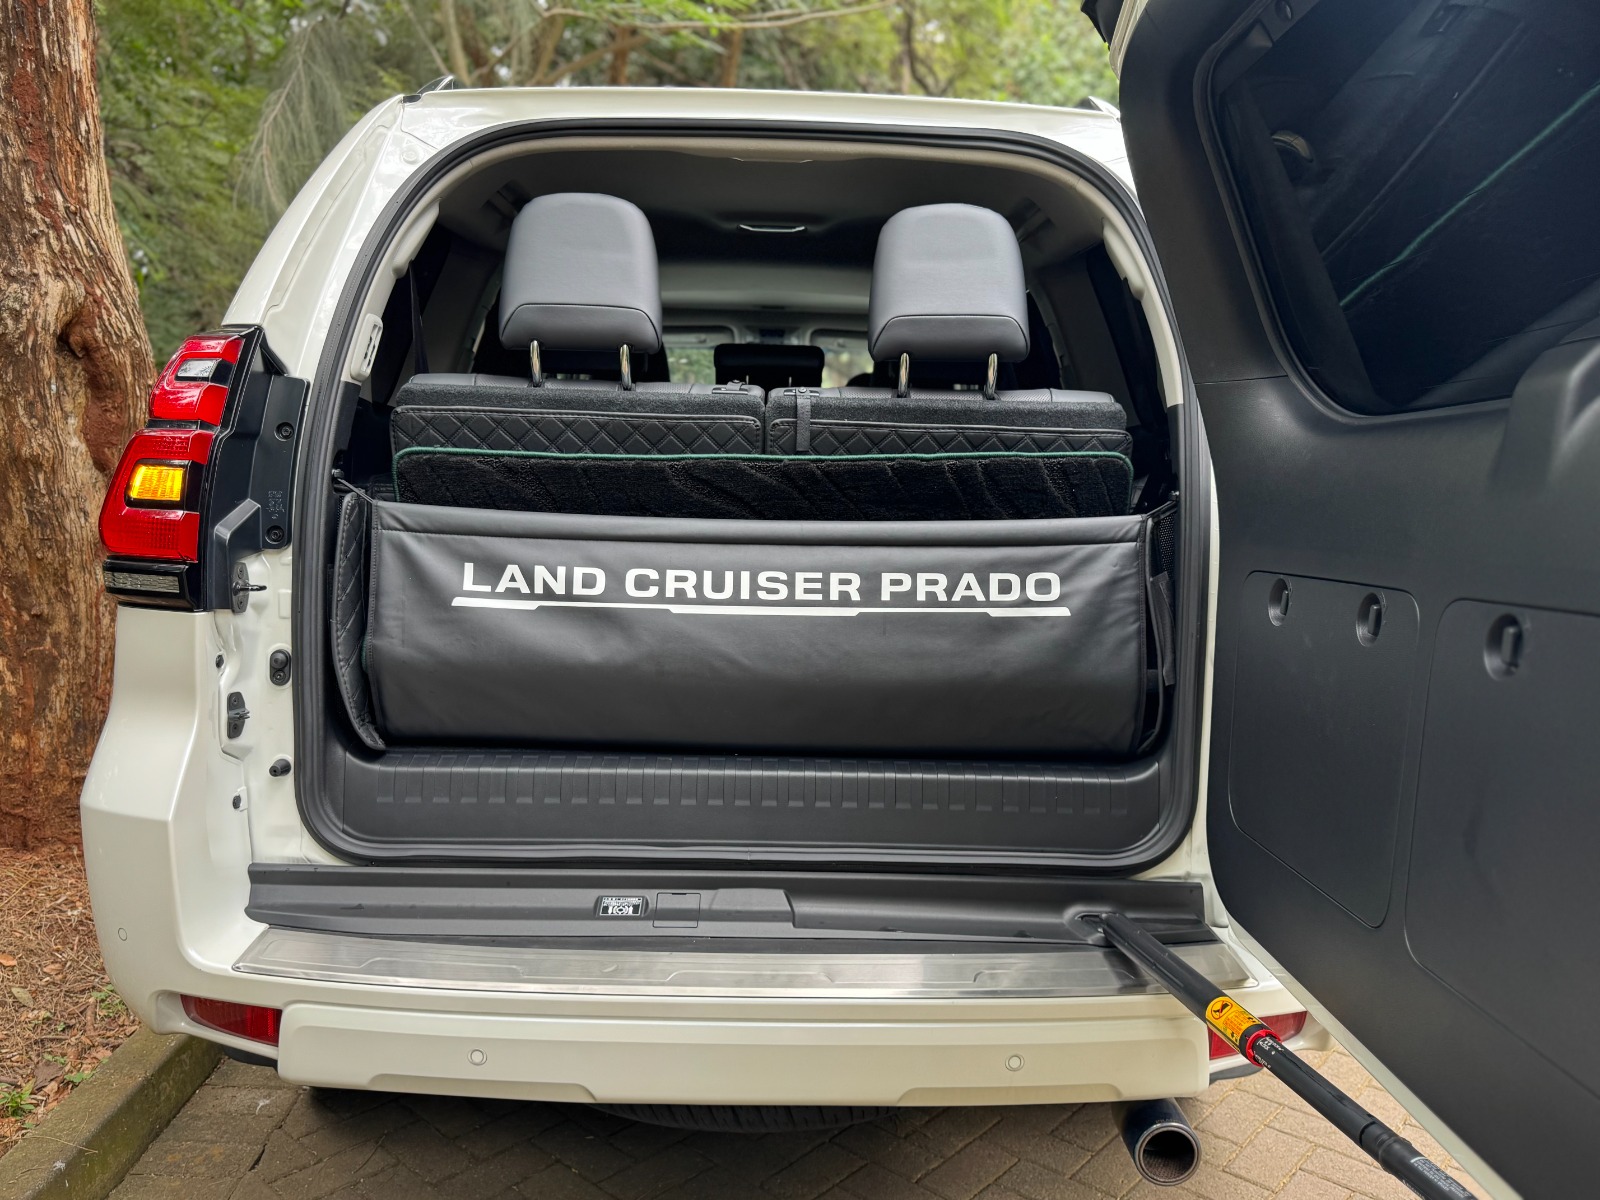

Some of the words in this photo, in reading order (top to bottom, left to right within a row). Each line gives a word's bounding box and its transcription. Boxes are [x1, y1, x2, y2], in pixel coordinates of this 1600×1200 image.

[462, 561, 607, 596] LAND
[624, 566, 861, 602] CRUISER
[880, 571, 1062, 602] PRADO
